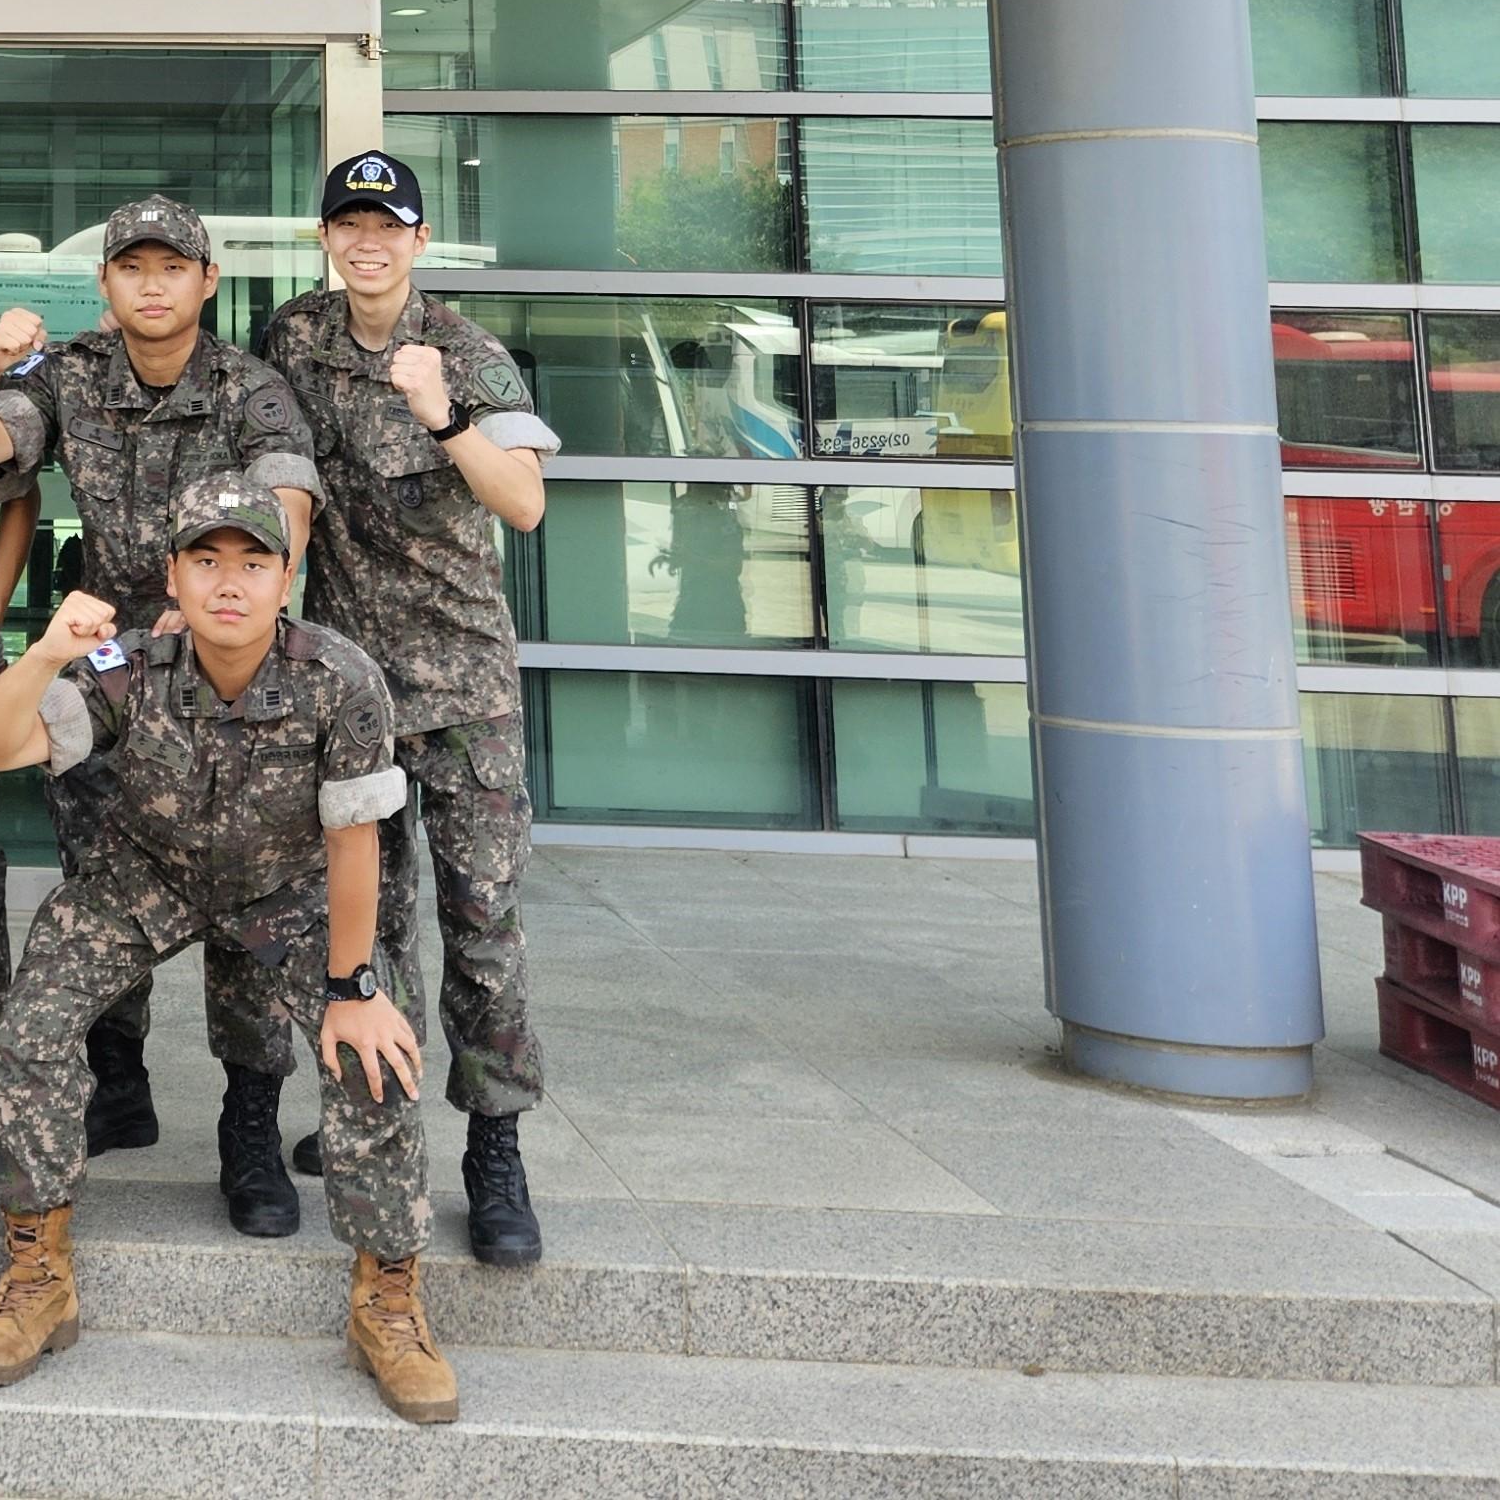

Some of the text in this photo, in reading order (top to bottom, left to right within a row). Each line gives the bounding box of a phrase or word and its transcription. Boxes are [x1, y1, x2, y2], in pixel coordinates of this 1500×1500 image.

[1443, 881, 1467, 909] KPP
[1460, 963, 1480, 989] KPP
[1473, 1043, 1498, 1071] KPP
